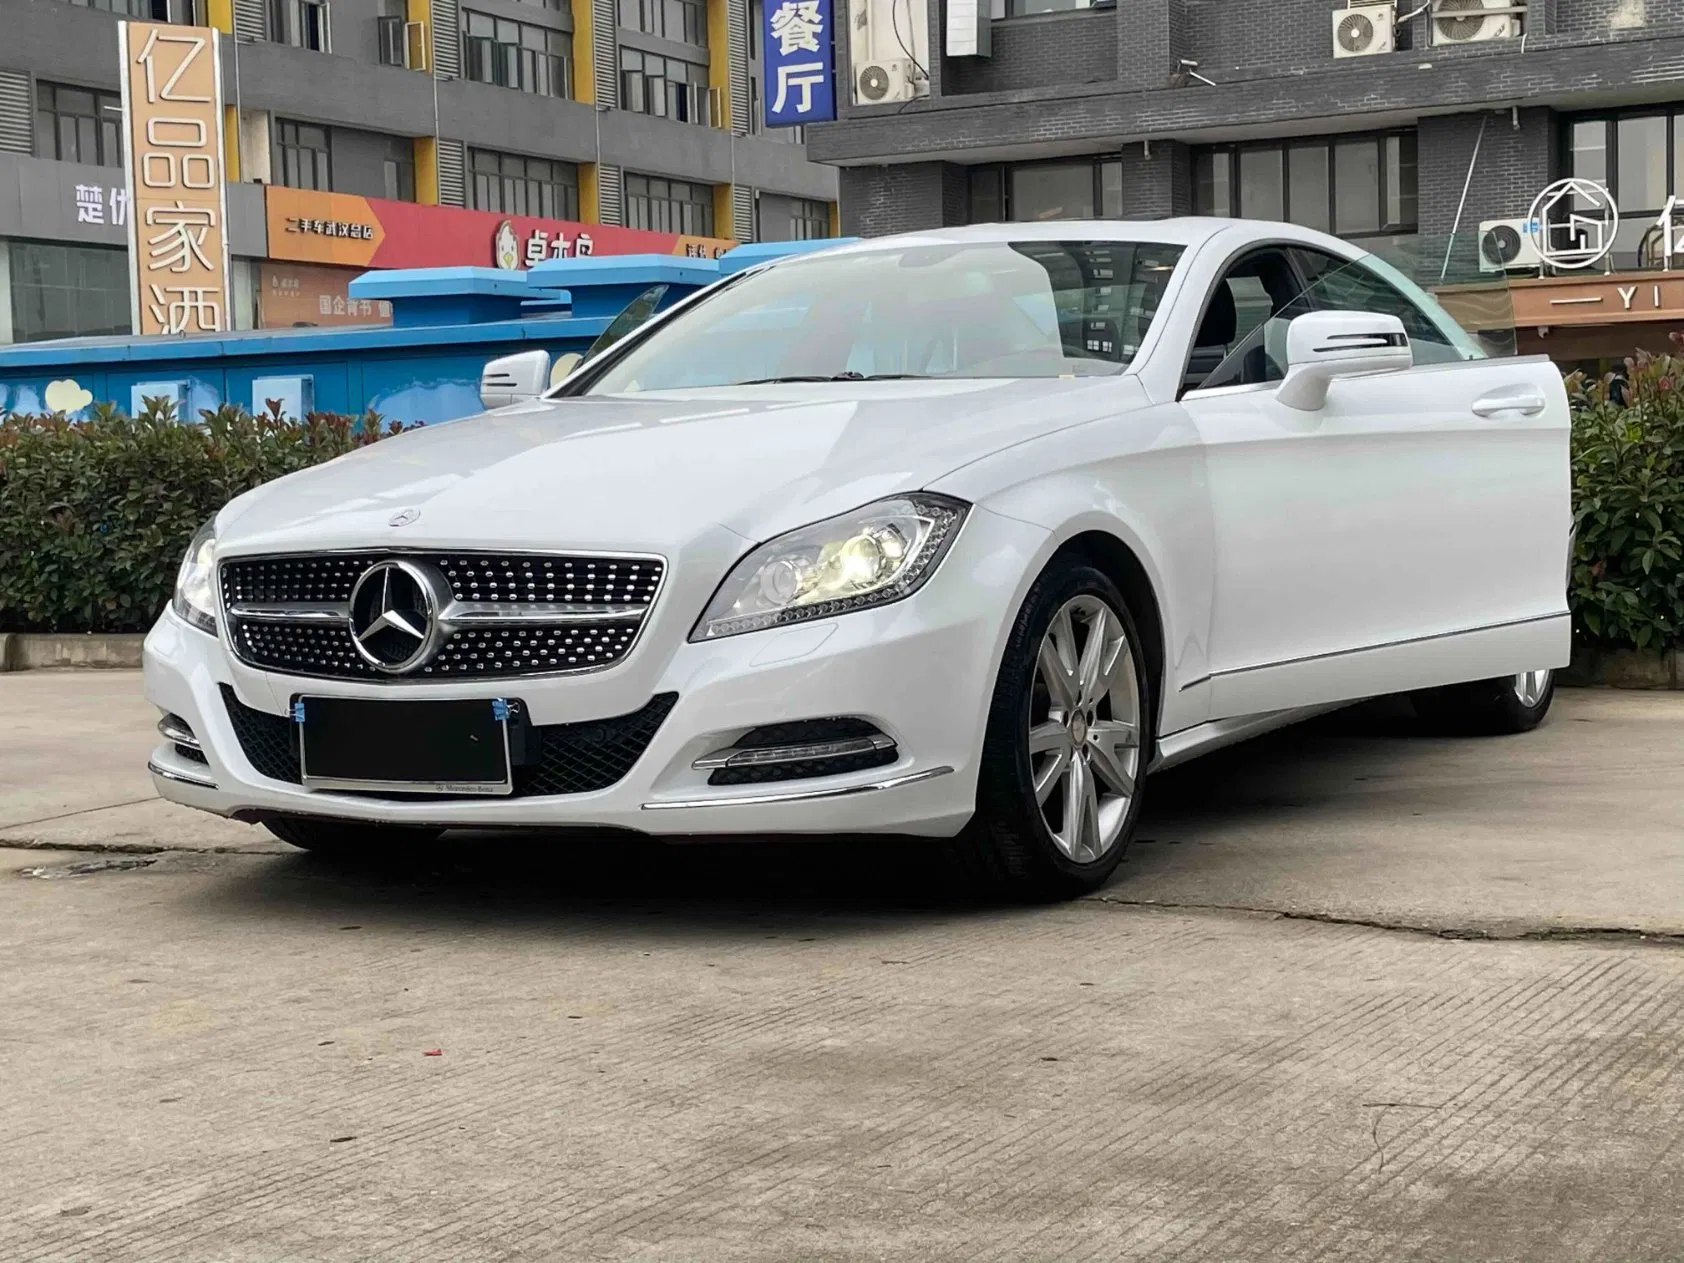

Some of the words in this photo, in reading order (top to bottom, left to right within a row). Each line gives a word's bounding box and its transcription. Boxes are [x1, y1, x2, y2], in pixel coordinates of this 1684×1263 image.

[769, 1, 824, 114] 餐厅
[285, 217, 374, 240] 二手车武汉总店
